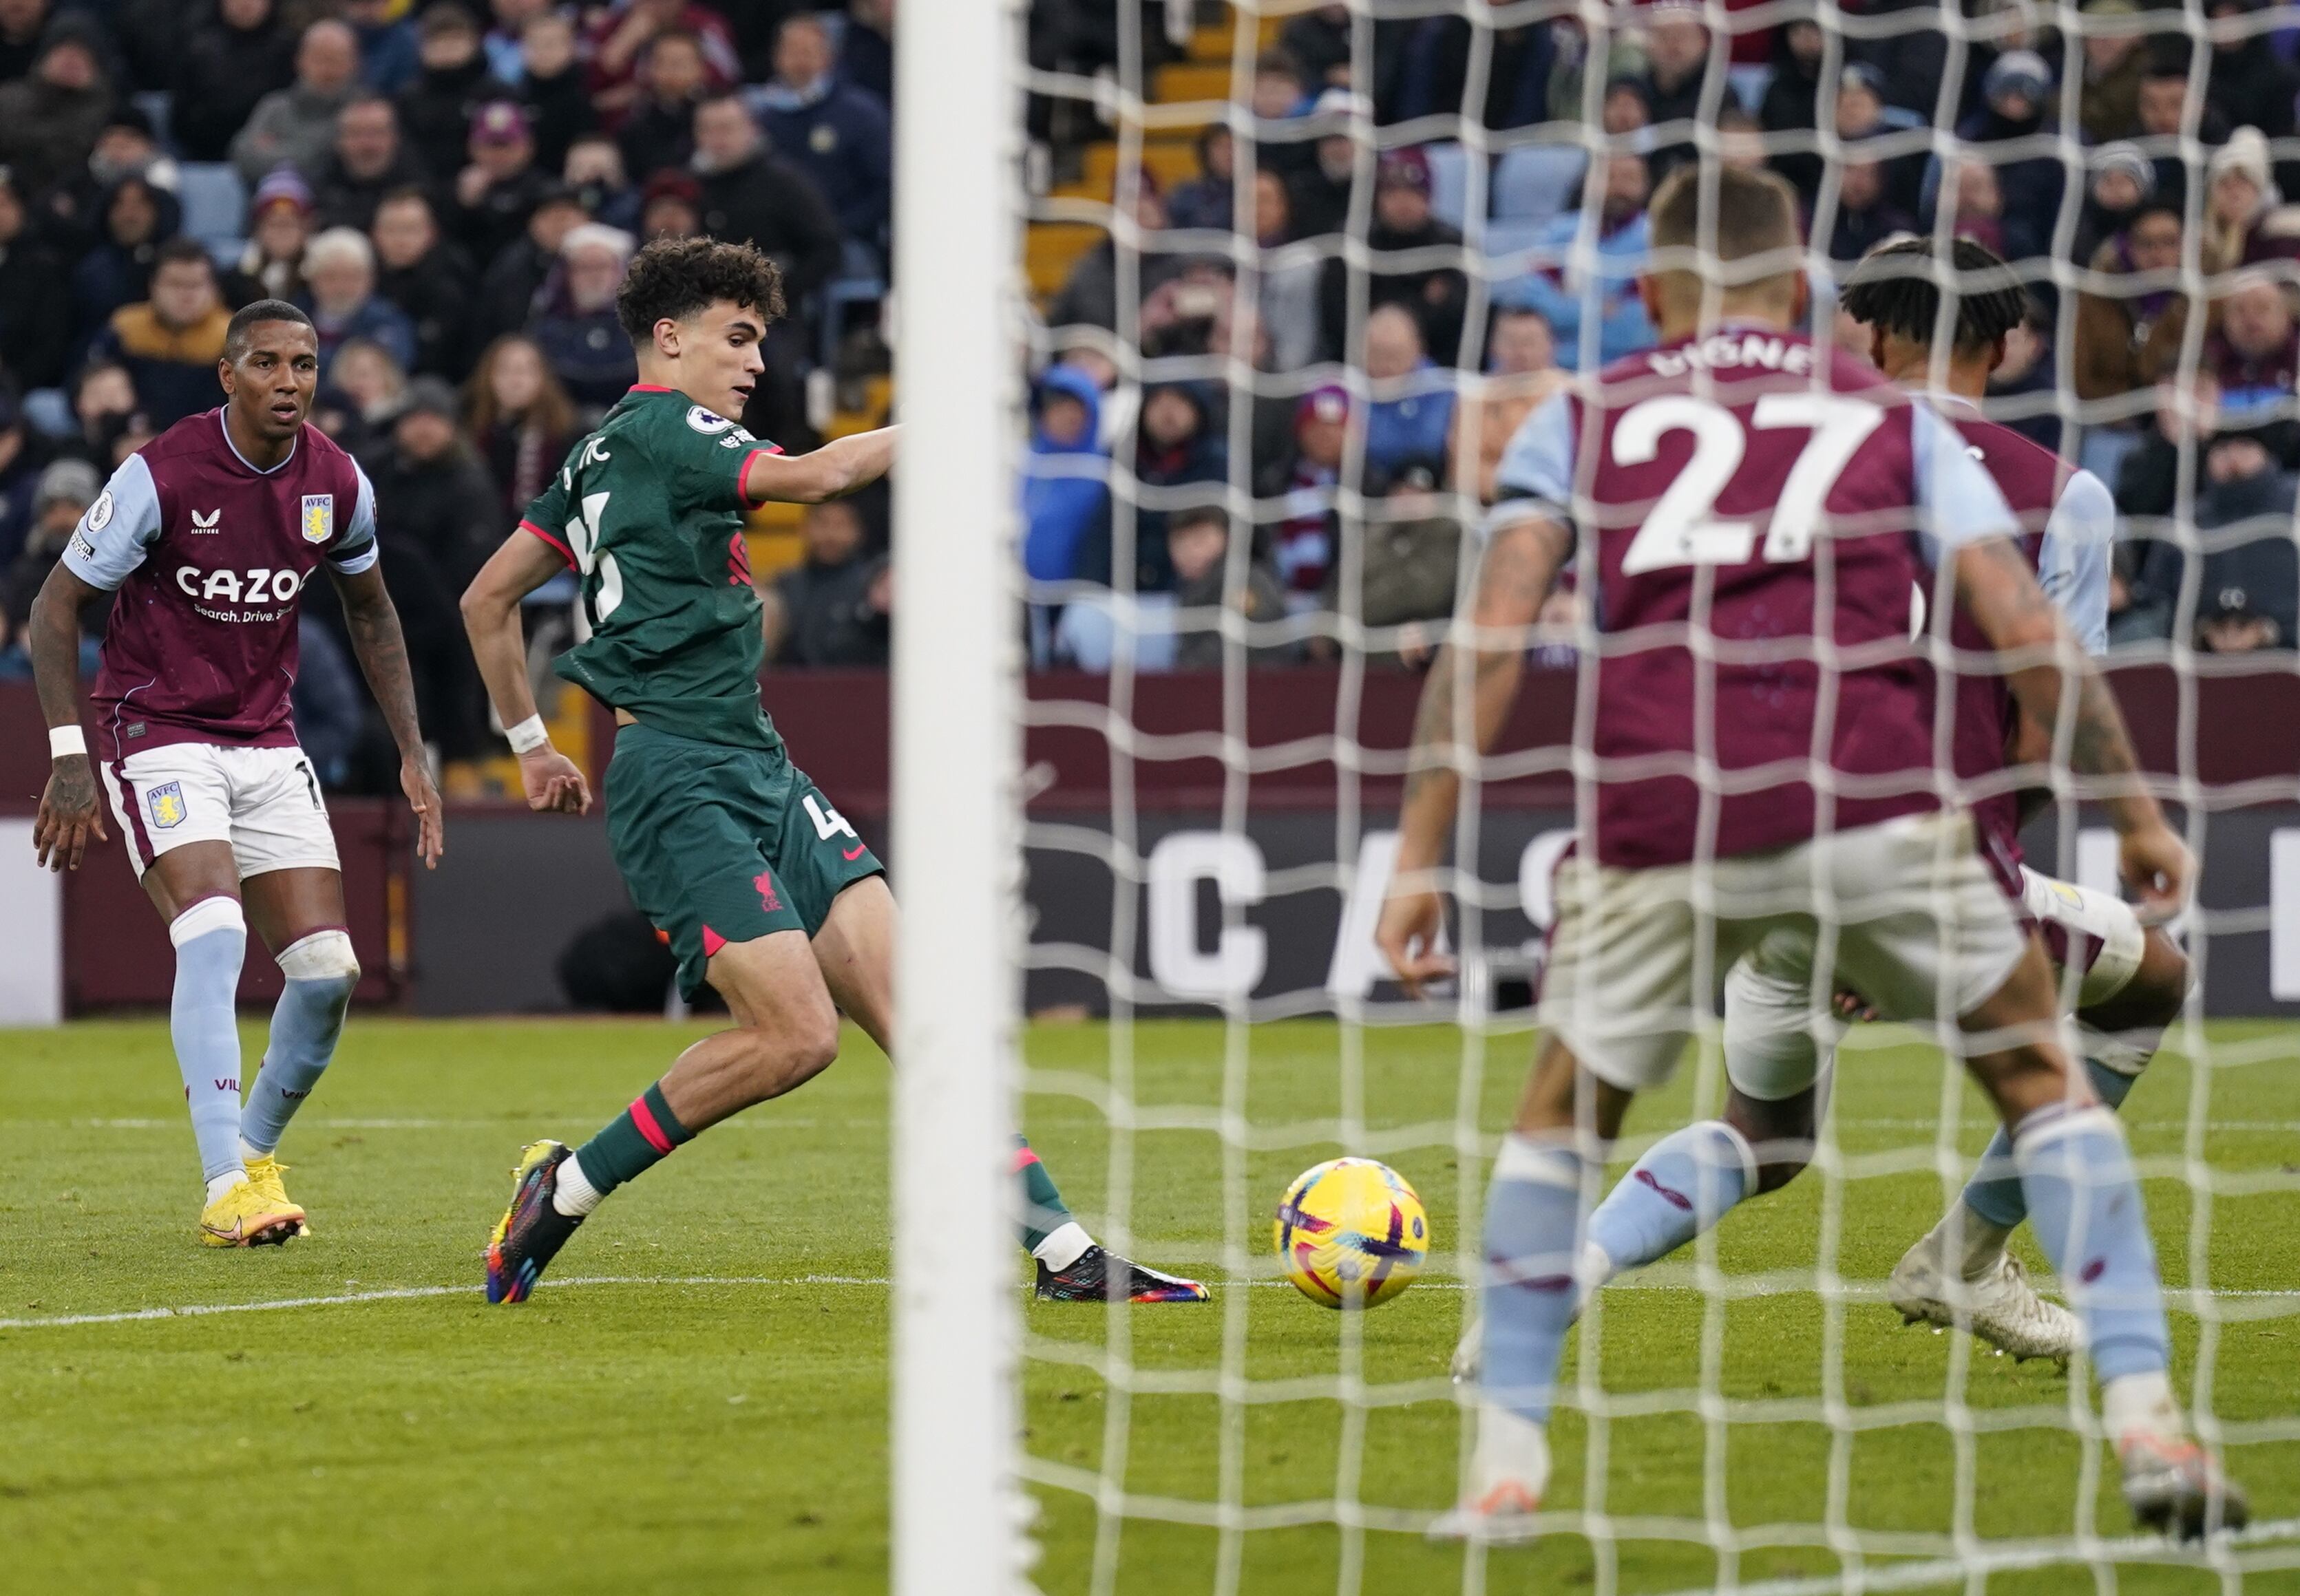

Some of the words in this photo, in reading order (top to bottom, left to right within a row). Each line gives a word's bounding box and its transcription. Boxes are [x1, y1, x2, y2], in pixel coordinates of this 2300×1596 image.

[1611, 394, 1885, 577] 27
[304, 497, 330, 507] AVFC
[176, 565, 317, 604] CAZO
[194, 603, 241, 623] Search.
[242, 610, 275, 623] Drive.
[150, 783, 179, 800] AVFC
